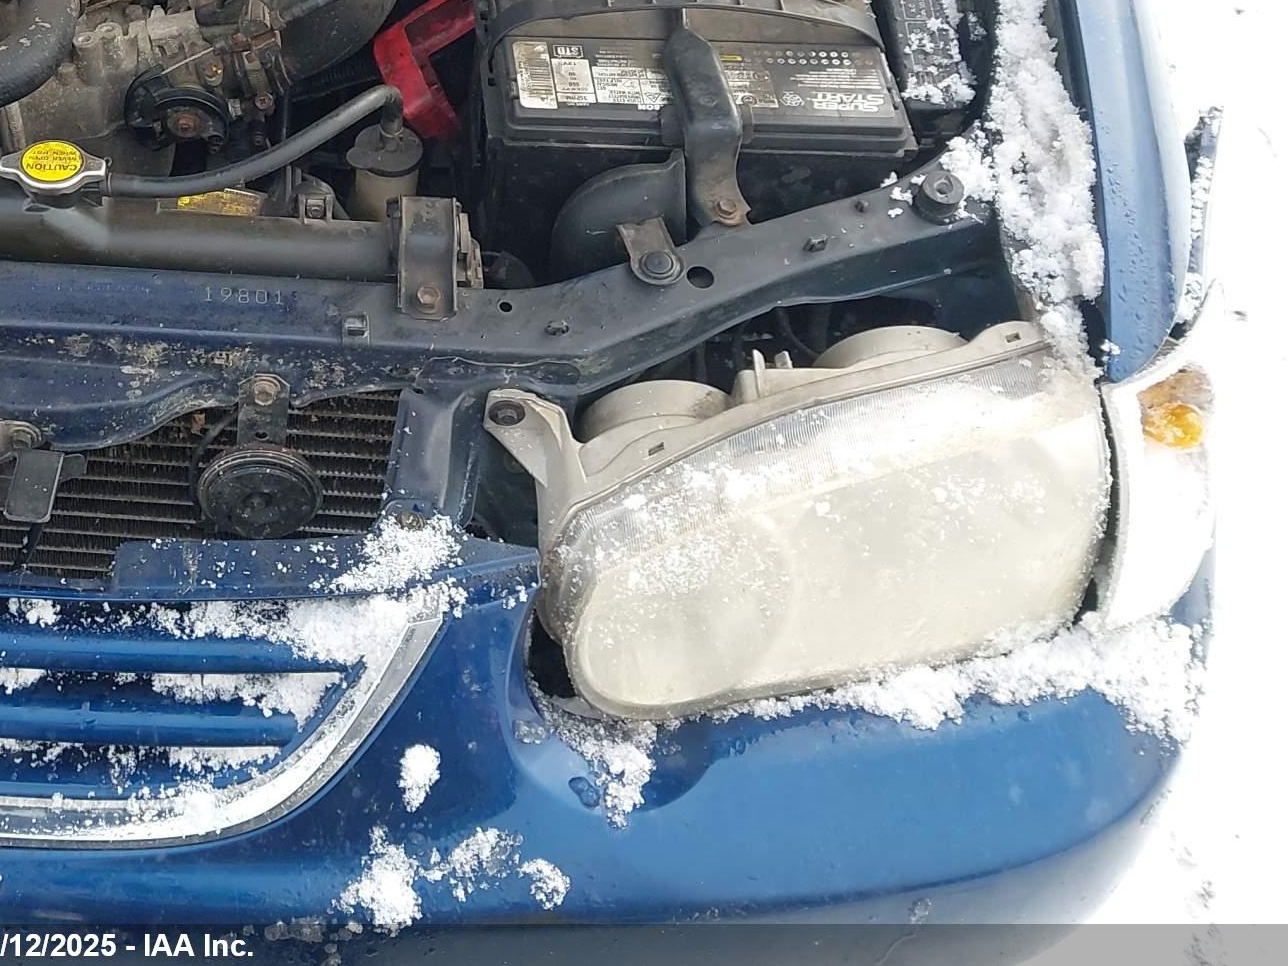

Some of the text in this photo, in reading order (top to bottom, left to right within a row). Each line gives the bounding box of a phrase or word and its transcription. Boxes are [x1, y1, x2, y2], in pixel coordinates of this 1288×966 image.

[807, 92, 885, 106] START
[812, 101, 880, 113] SUPER
[26, 163, 78, 171] CAUTION
